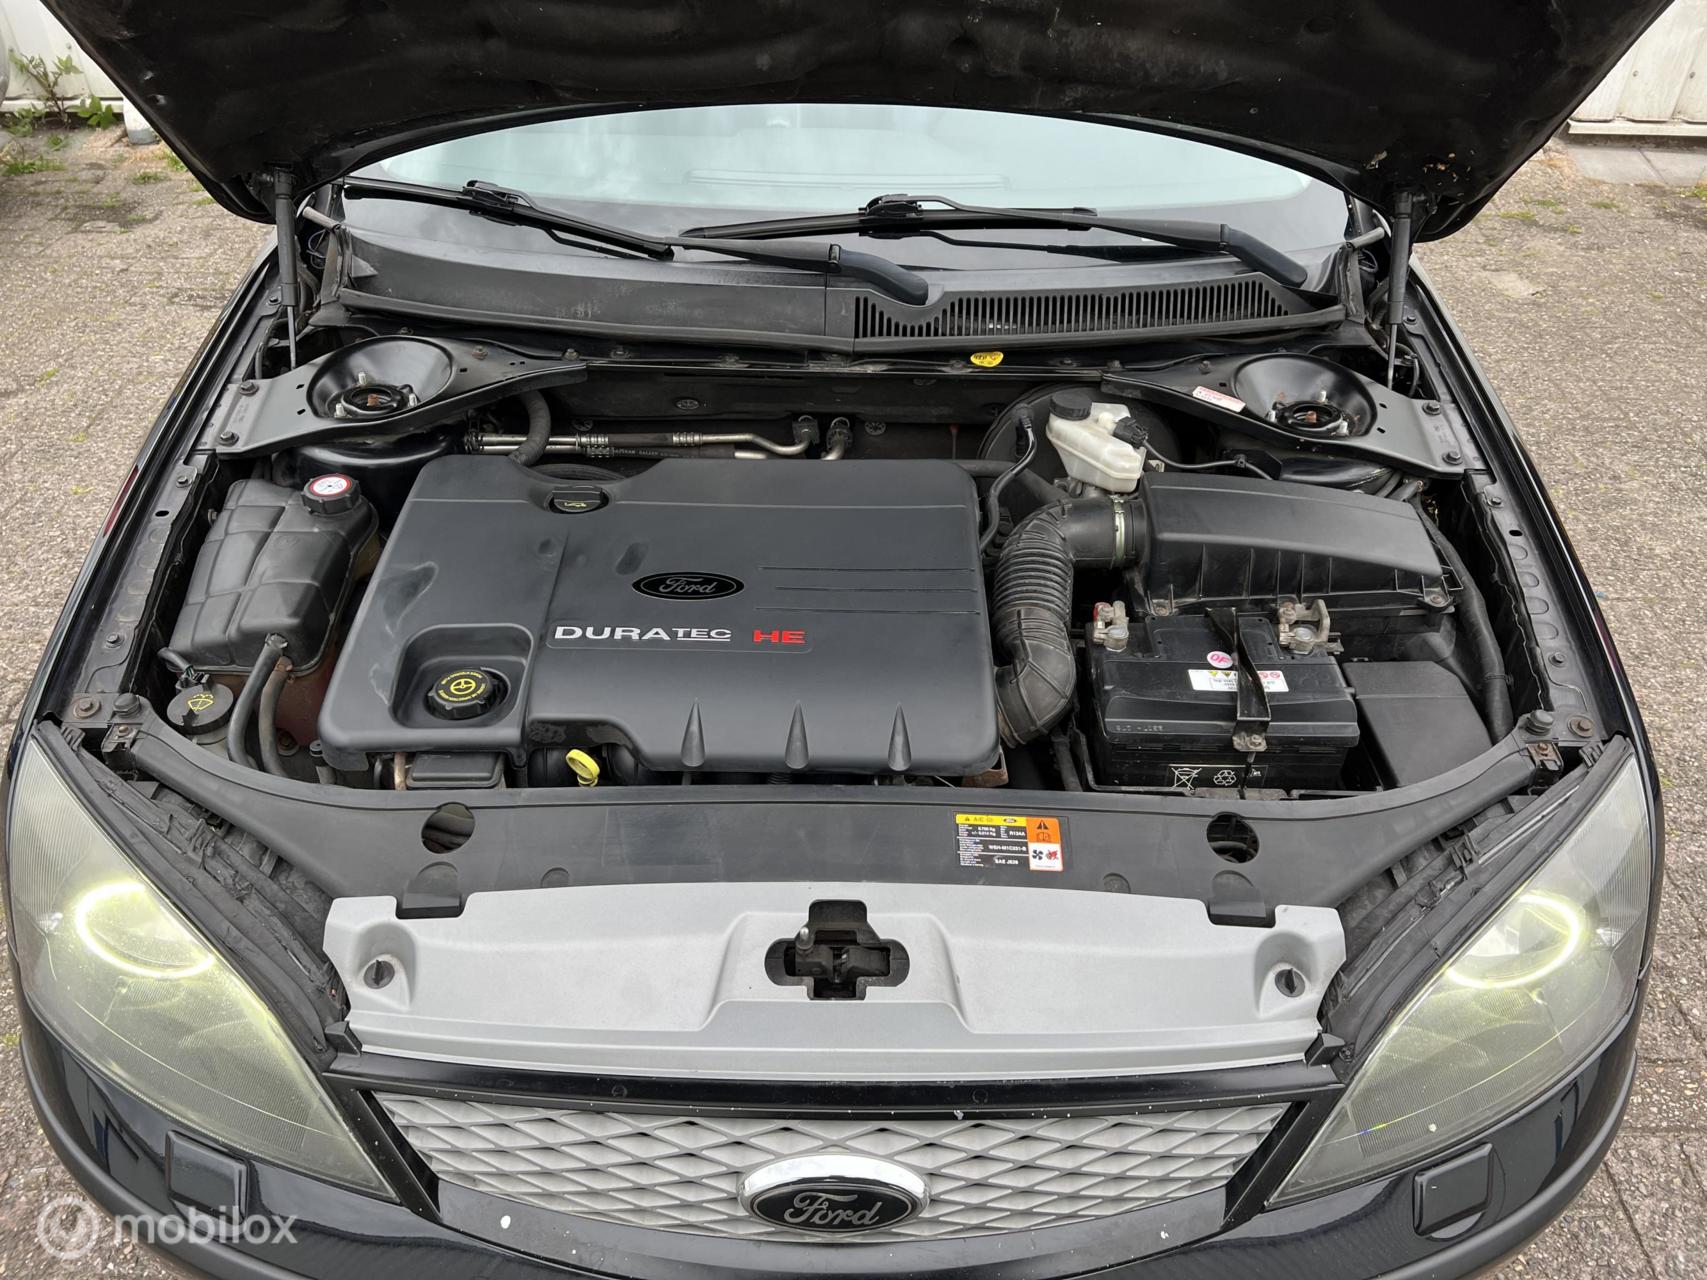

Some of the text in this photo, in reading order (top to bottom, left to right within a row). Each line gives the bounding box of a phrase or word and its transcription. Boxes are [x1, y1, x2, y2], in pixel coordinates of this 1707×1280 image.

[659, 574, 717, 593] Ford
[554, 626, 806, 644] DURATEC HE
[783, 1191, 883, 1225] Ford
